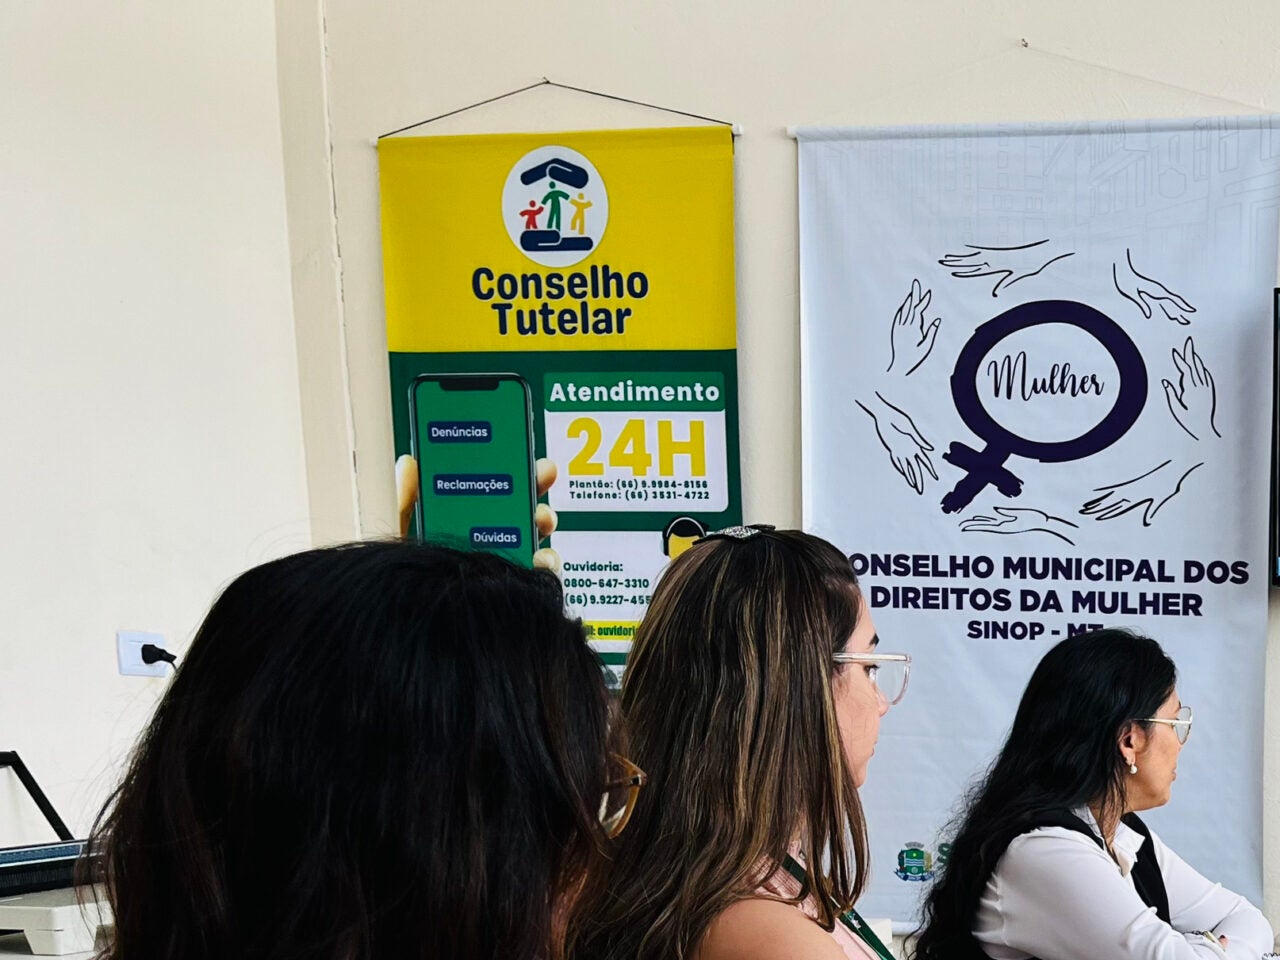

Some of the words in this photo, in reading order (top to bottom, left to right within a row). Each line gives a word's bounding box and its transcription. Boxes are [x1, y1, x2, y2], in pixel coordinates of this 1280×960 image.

[472, 264, 649, 301] Conselho
[491, 301, 632, 336] Tutelar
[987, 351, 1104, 402] Mulher
[550, 380, 720, 402] Atendimento
[431, 425, 488, 438] Denúncias
[566, 417, 706, 477] 24H
[436, 477, 510, 493] Reclamações
[569, 479, 614, 489] Plantão:
[616, 478, 638, 490] (66)
[641, 480, 708, 489] 9.9984-8156
[570, 491, 621, 500] Telefone:
[625, 490, 648, 501] (66)
[652, 491, 710, 500] 3531-4722
[473, 532, 518, 546] Dúvidas
[563, 561, 624, 572] Ouvidoria:
[849, 552, 994, 579] ONSELHO
[1003, 555, 1174, 584] MUNICIPAL
[1183, 560, 1250, 585] DOS
[564, 578, 650, 589] 0800-647-3310
[565, 593, 588, 607] (66)
[871, 586, 1012, 612] DIREITOS
[1020, 589, 1063, 613] DA
[1071, 591, 1203, 617] MULHER
[597, 625, 638, 636] ouvidori
[967, 620, 1044, 641] SINOP
